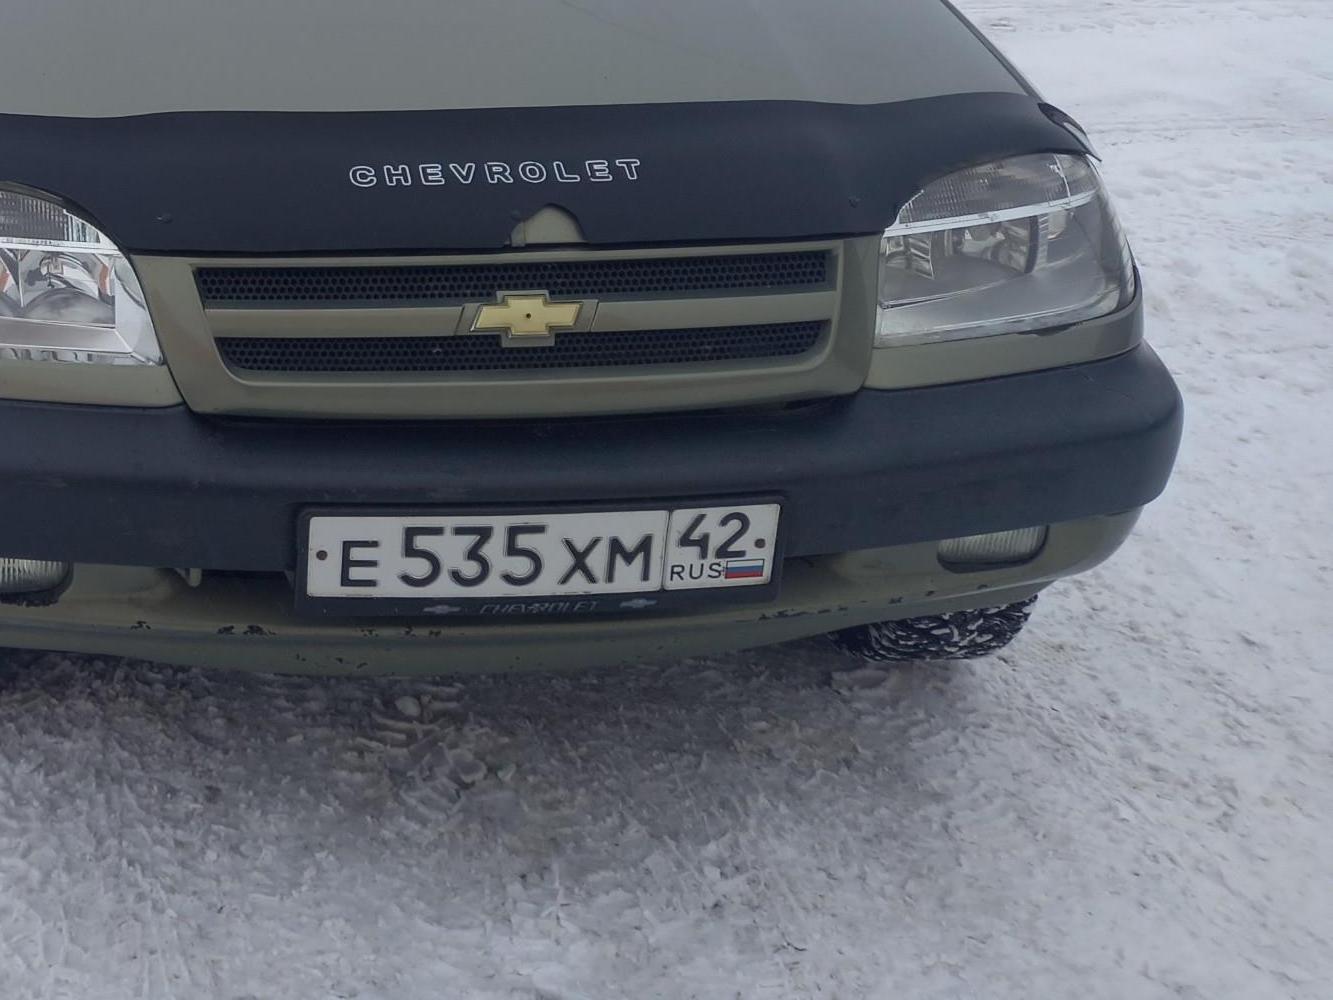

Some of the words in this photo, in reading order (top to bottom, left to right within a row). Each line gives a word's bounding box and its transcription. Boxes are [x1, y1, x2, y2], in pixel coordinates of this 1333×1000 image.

[349, 158, 641, 188] CHEVROLET
[678, 512, 751, 560] 42
[670, 562, 722, 582] RUS
[479, 602, 599, 615] CHEVROLET
